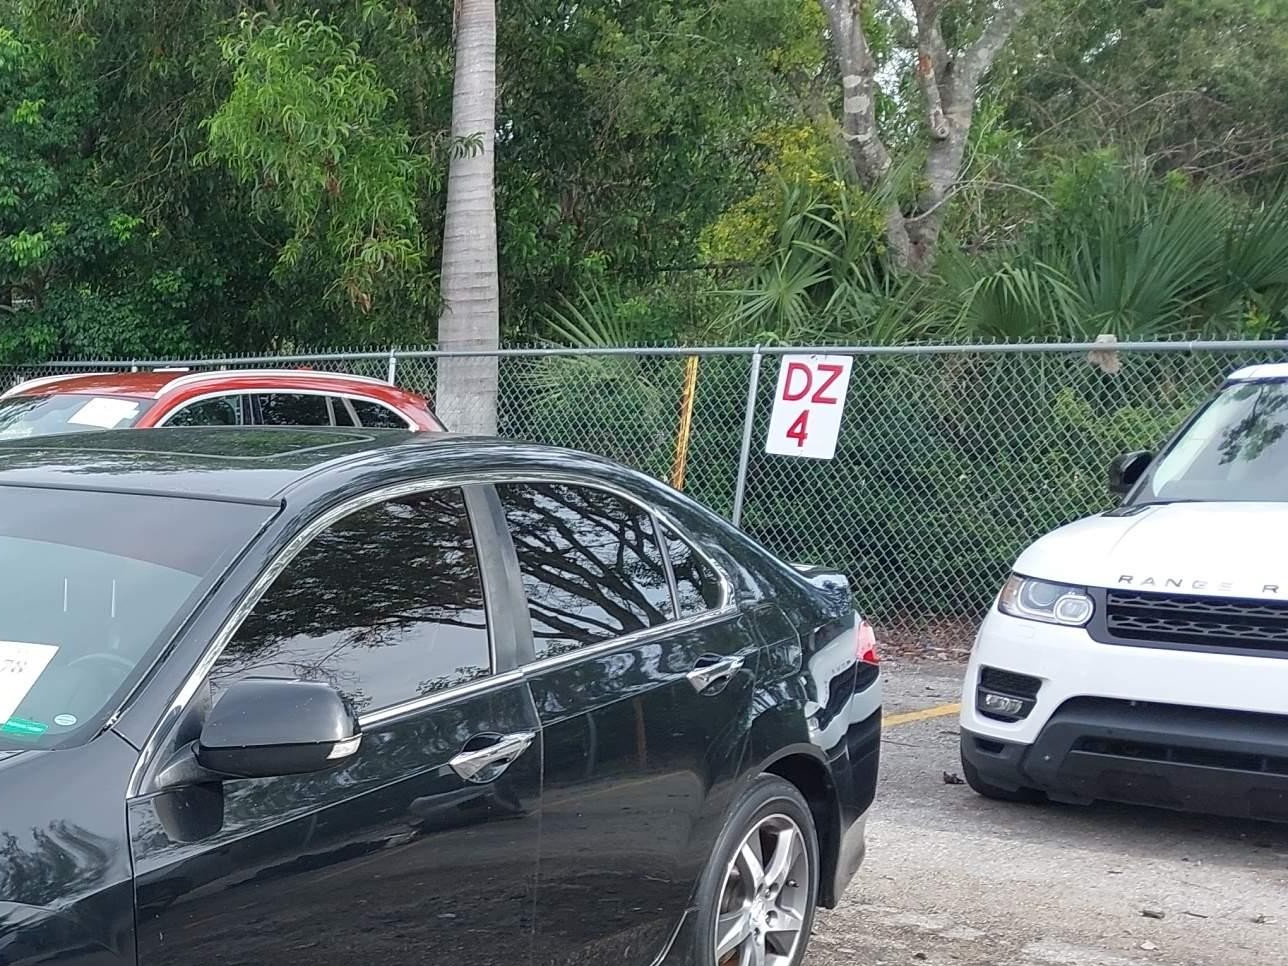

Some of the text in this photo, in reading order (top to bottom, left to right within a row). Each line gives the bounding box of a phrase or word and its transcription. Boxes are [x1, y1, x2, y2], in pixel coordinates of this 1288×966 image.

[783, 363, 844, 404] DZ
[786, 410, 810, 447] 4
[1118, 574, 1234, 592] RANGE
